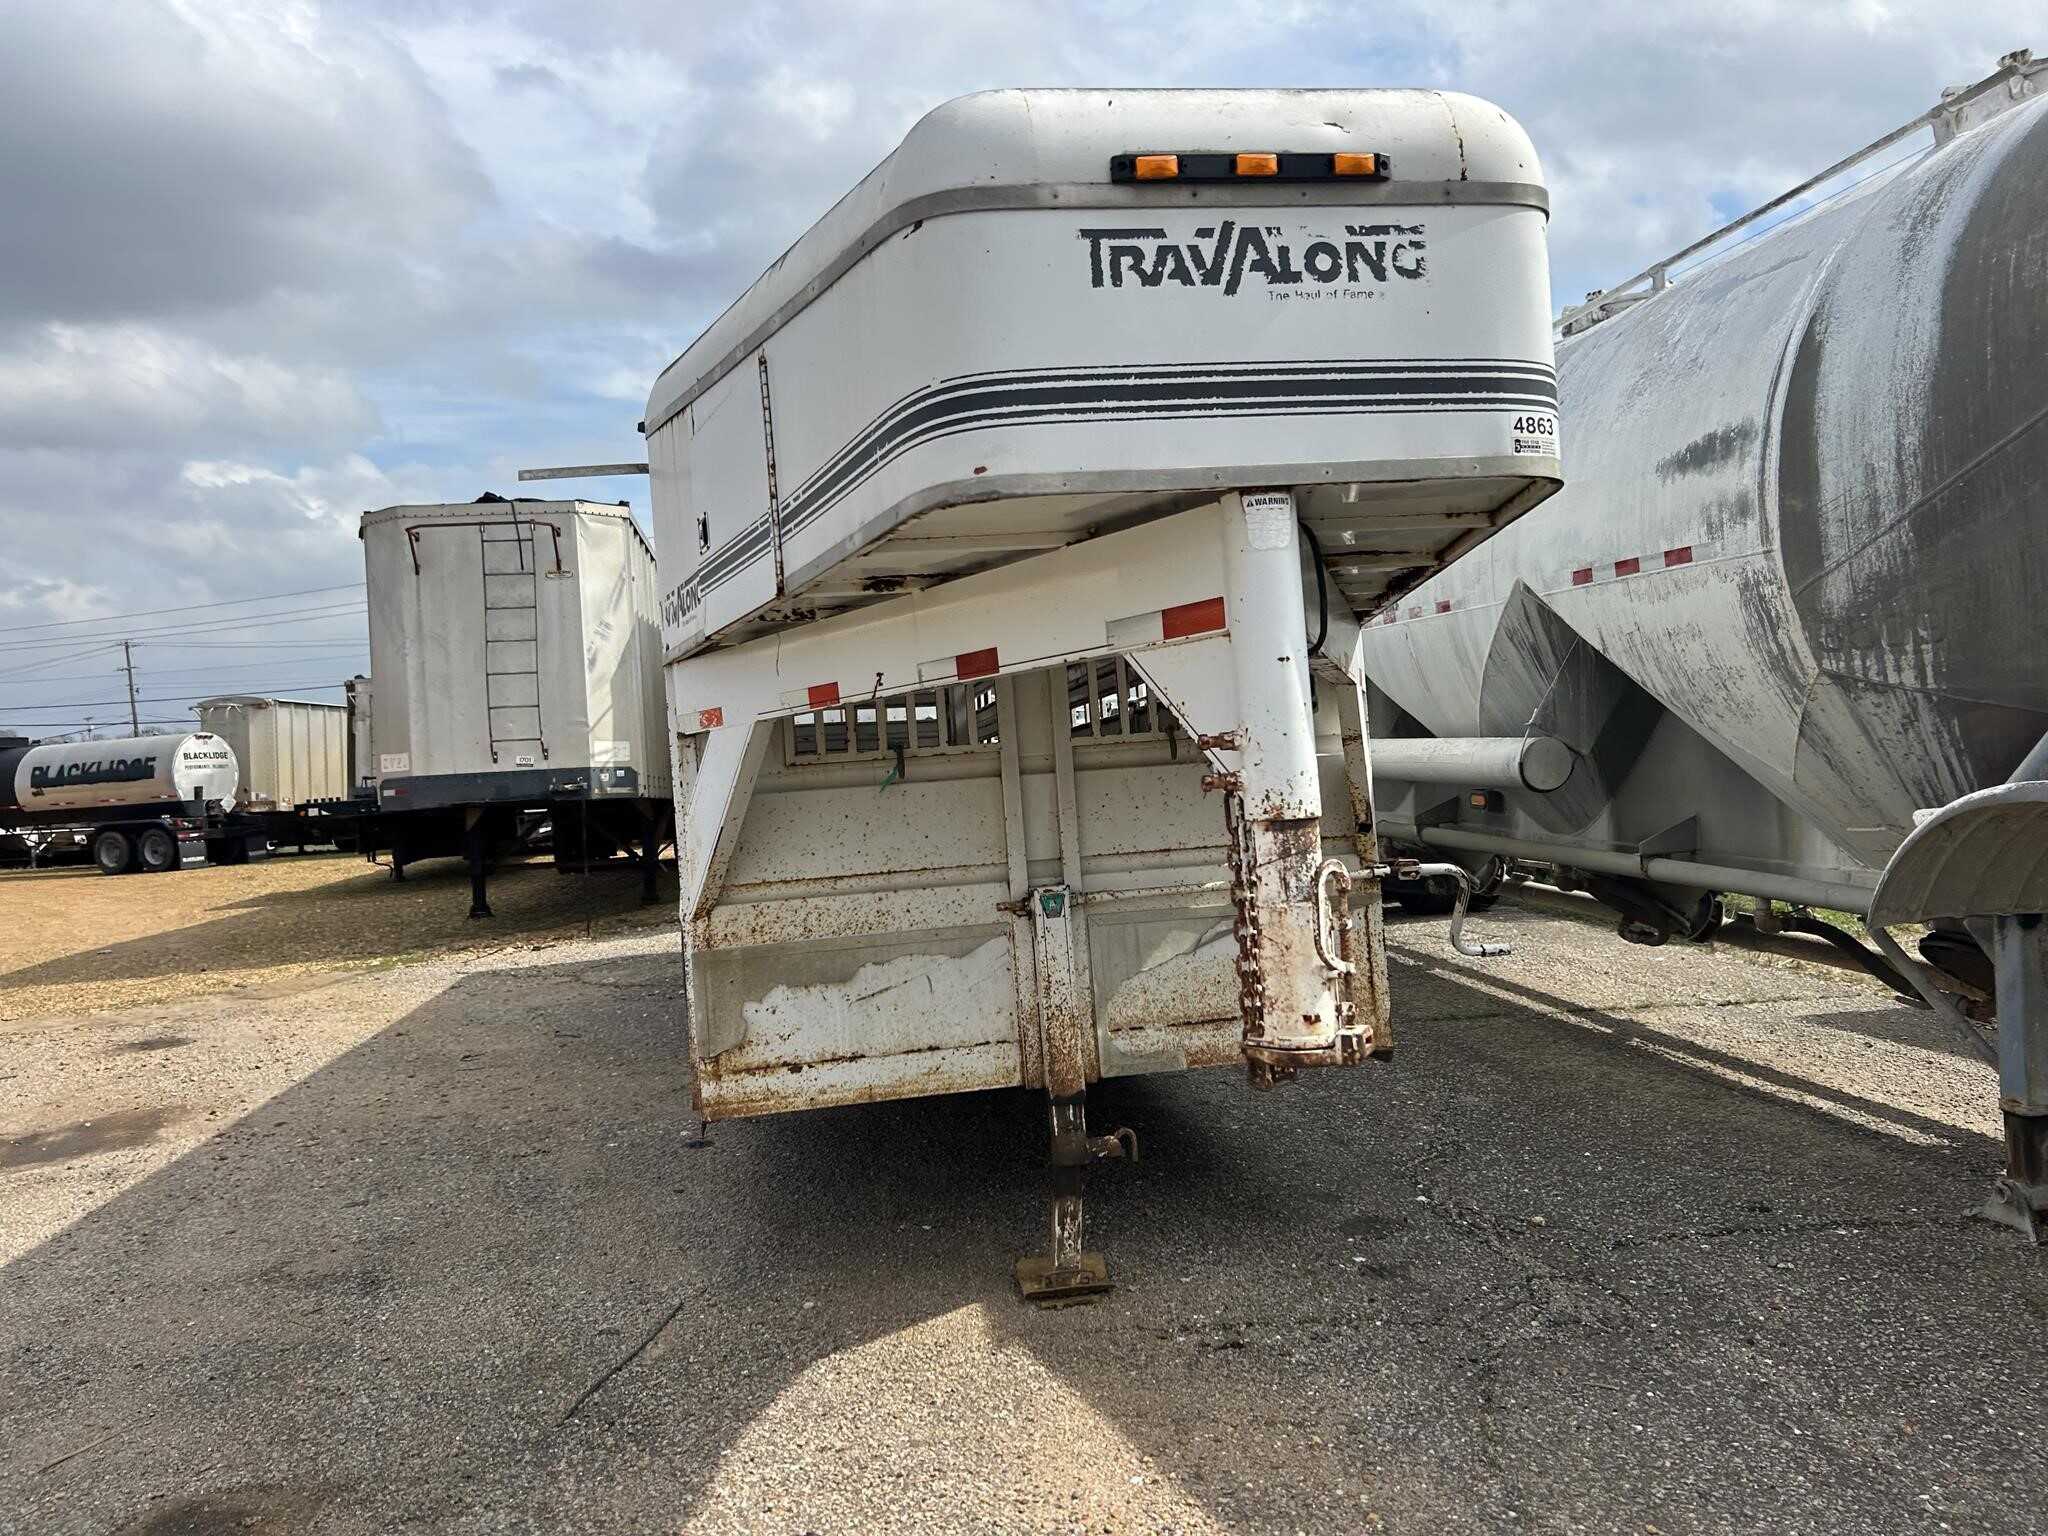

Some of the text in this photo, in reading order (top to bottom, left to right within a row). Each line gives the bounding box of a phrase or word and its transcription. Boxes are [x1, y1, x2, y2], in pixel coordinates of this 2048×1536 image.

[1077, 219, 1427, 296] TRAVALONG
[1268, 290, 1290, 301] The
[1326, 289, 1338, 299] of
[1343, 288, 1375, 300] Fame
[1513, 416, 1553, 436] 4863
[183, 751, 229, 760] BLACKLIDGE
